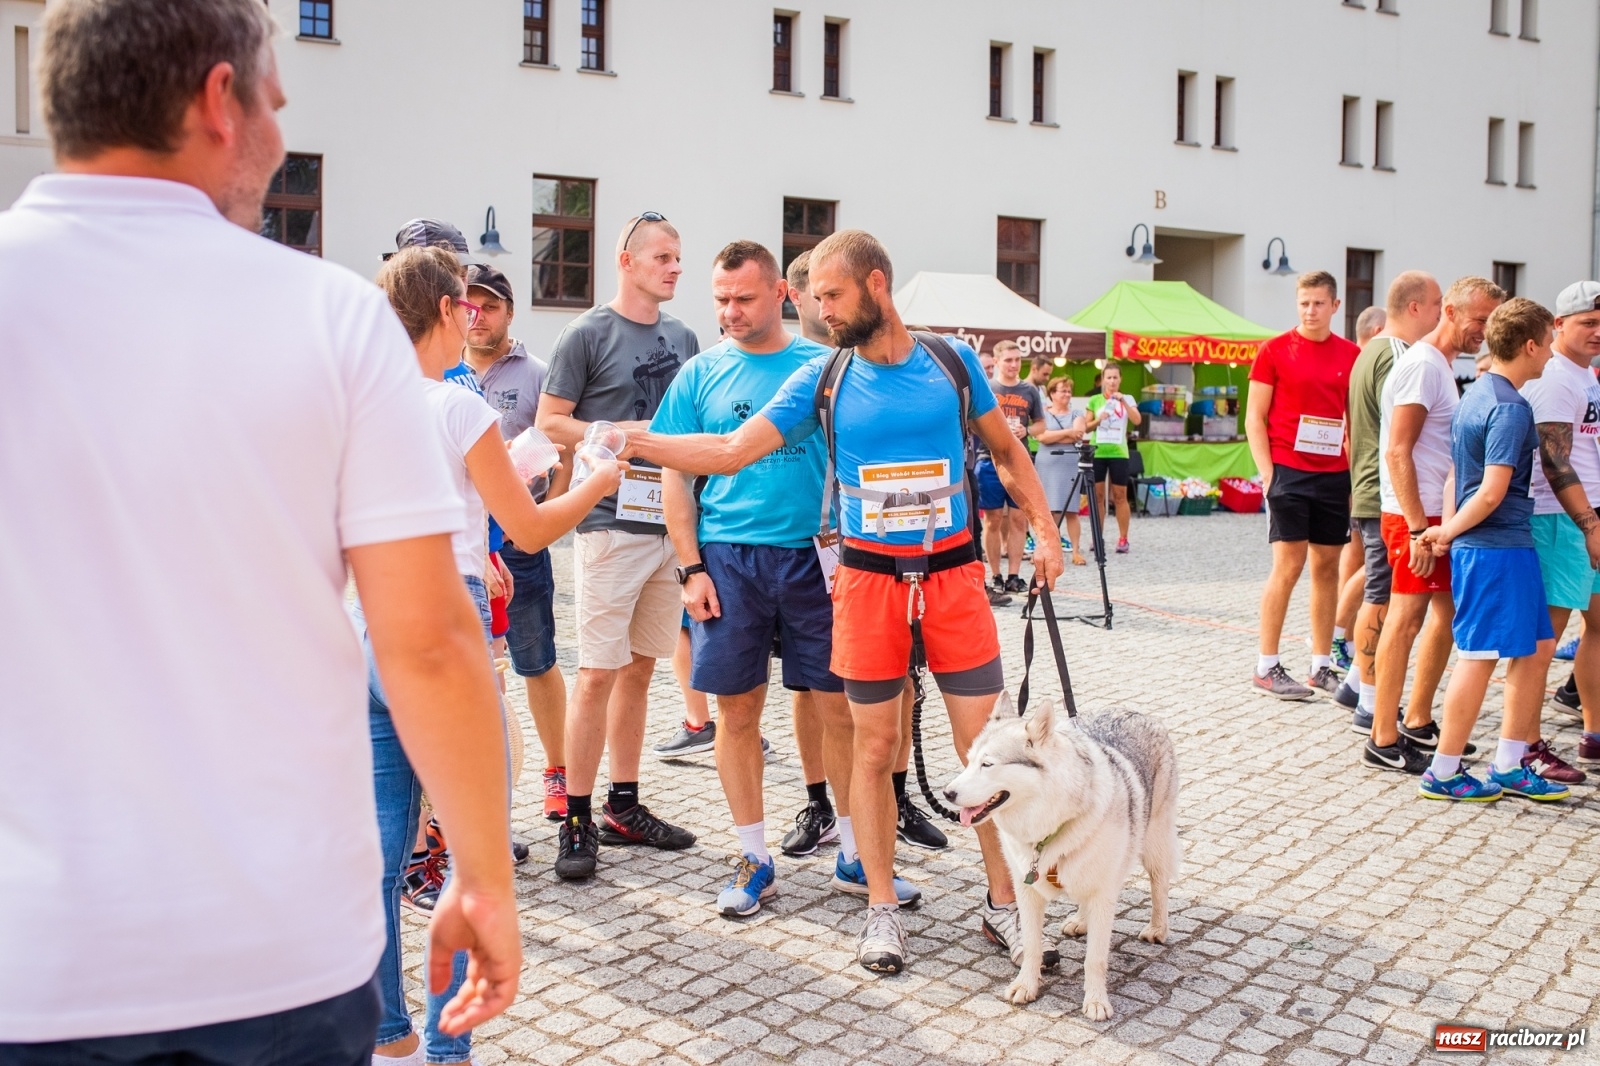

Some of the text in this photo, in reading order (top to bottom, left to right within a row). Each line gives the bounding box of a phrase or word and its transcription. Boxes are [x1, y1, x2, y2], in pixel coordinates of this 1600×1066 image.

[1154, 189, 1167, 209] B
[956, 328, 985, 354] fry
[1016, 331, 1072, 358] gofry
[1137, 337, 1206, 358] SORBETY
[1317, 430, 1329, 440] 56
[647, 489, 663, 503] 41
